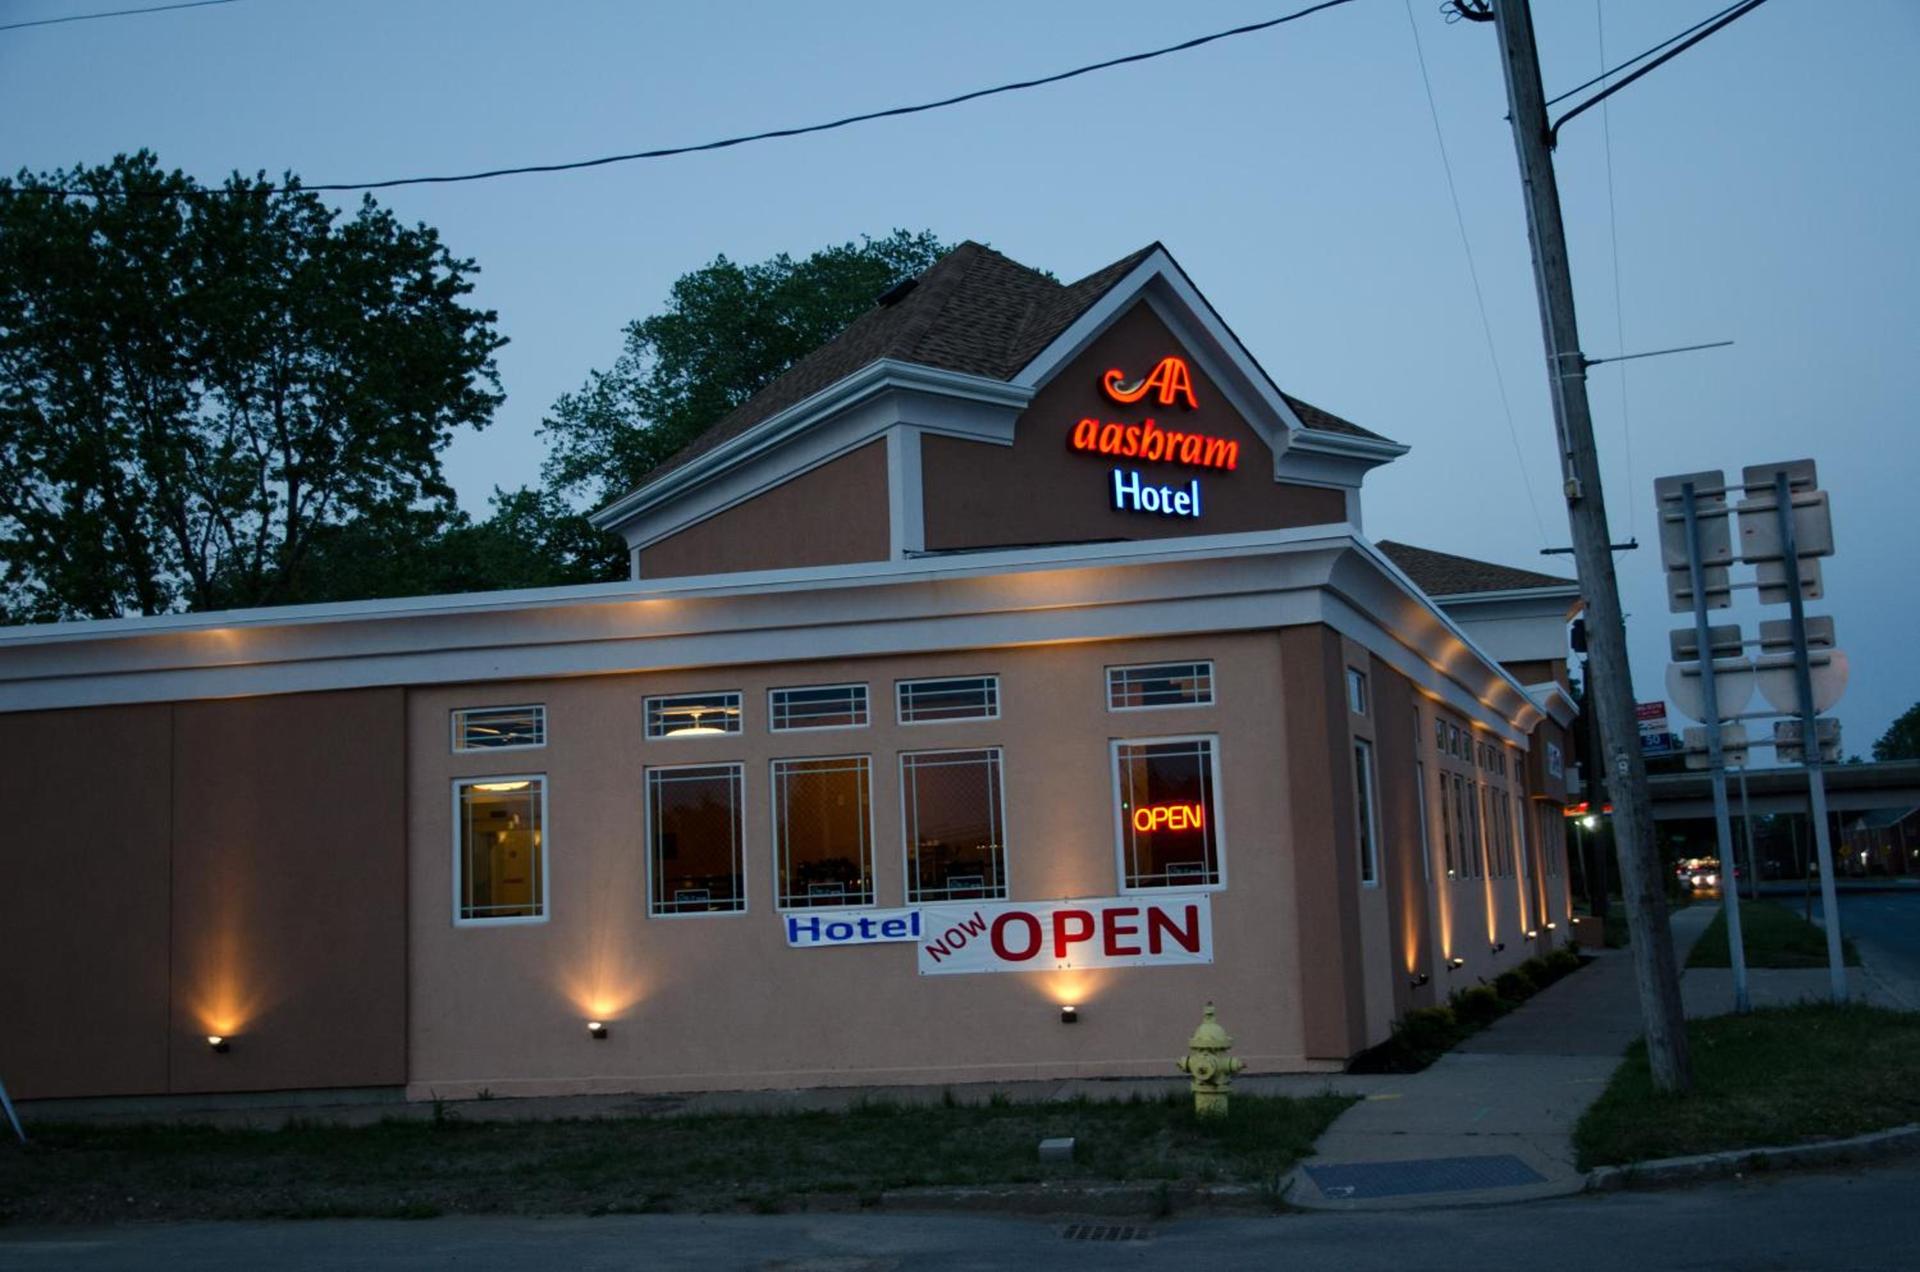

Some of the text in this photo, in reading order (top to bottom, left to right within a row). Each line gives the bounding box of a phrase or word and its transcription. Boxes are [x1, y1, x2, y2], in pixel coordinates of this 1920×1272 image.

[1073, 418, 1239, 470] aashram
[1113, 469, 1200, 516] Hotel
[1133, 804, 1202, 831] OPEN
[788, 911, 920, 942] Hotel
[925, 905, 1200, 962] NOW OPEN
